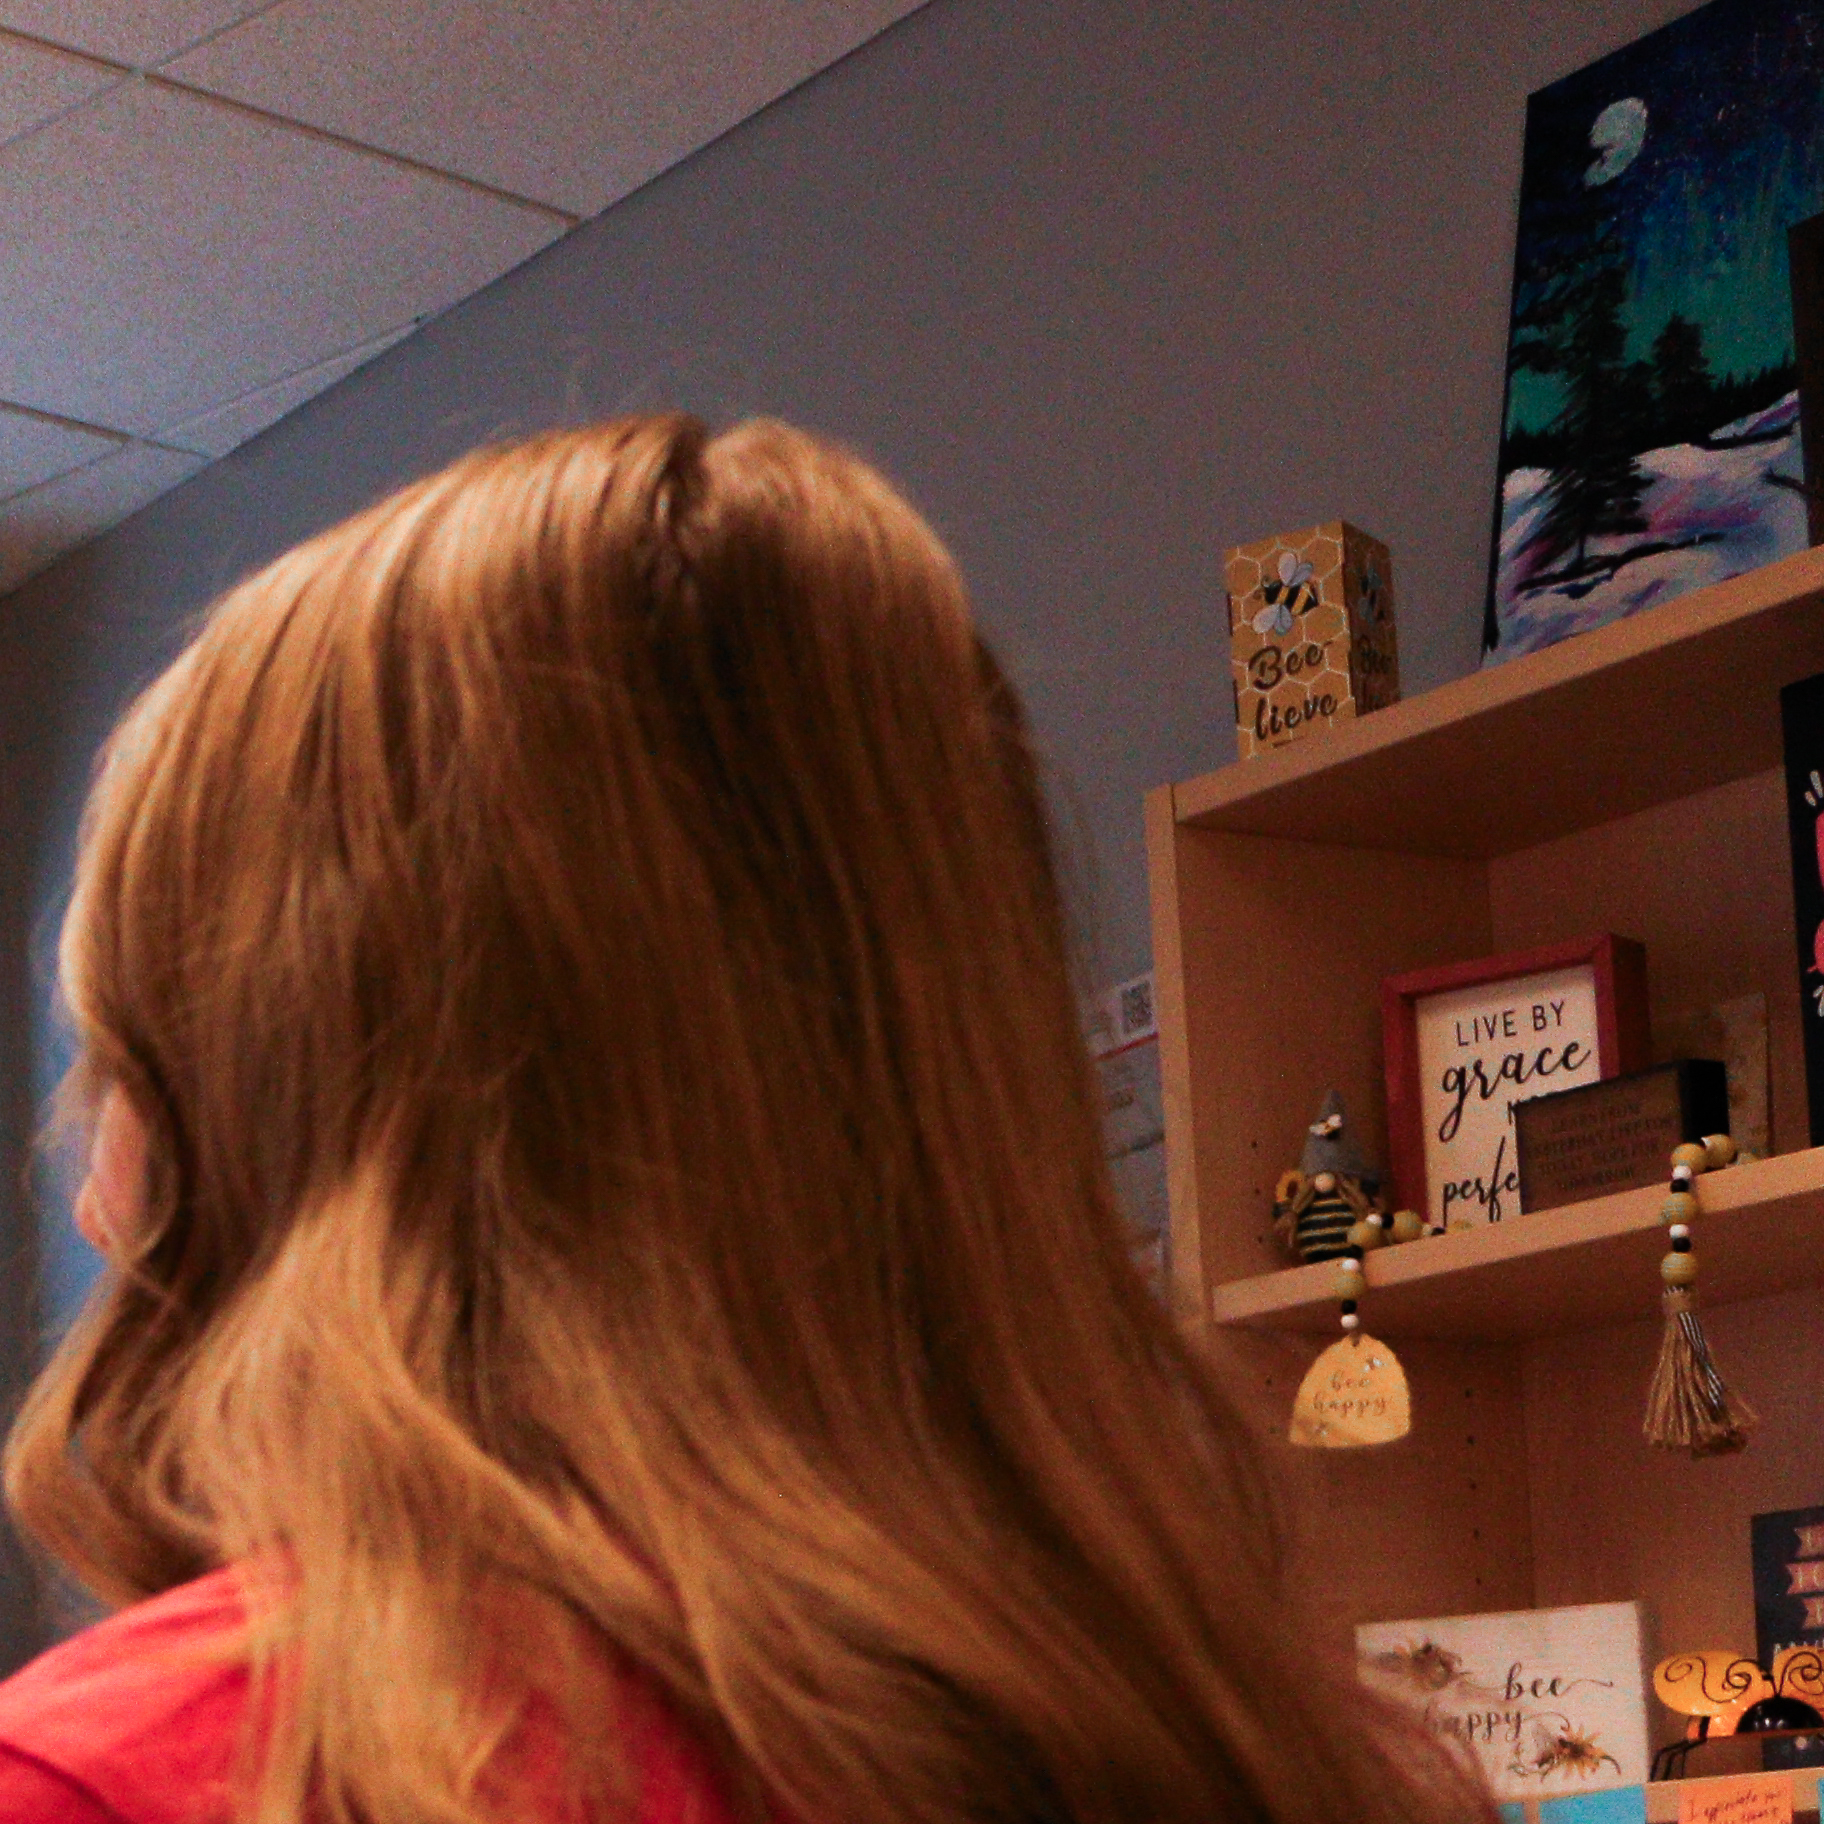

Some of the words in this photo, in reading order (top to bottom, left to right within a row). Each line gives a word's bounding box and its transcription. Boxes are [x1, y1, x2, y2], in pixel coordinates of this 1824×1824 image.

[1255, 693, 1338, 740] lieve
[1455, 1010, 1518, 1047] LIVE
[1532, 1000, 1565, 1032] BY
[1439, 1041, 1592, 1143] grace
[1502, 1661, 1613, 1700] bee
